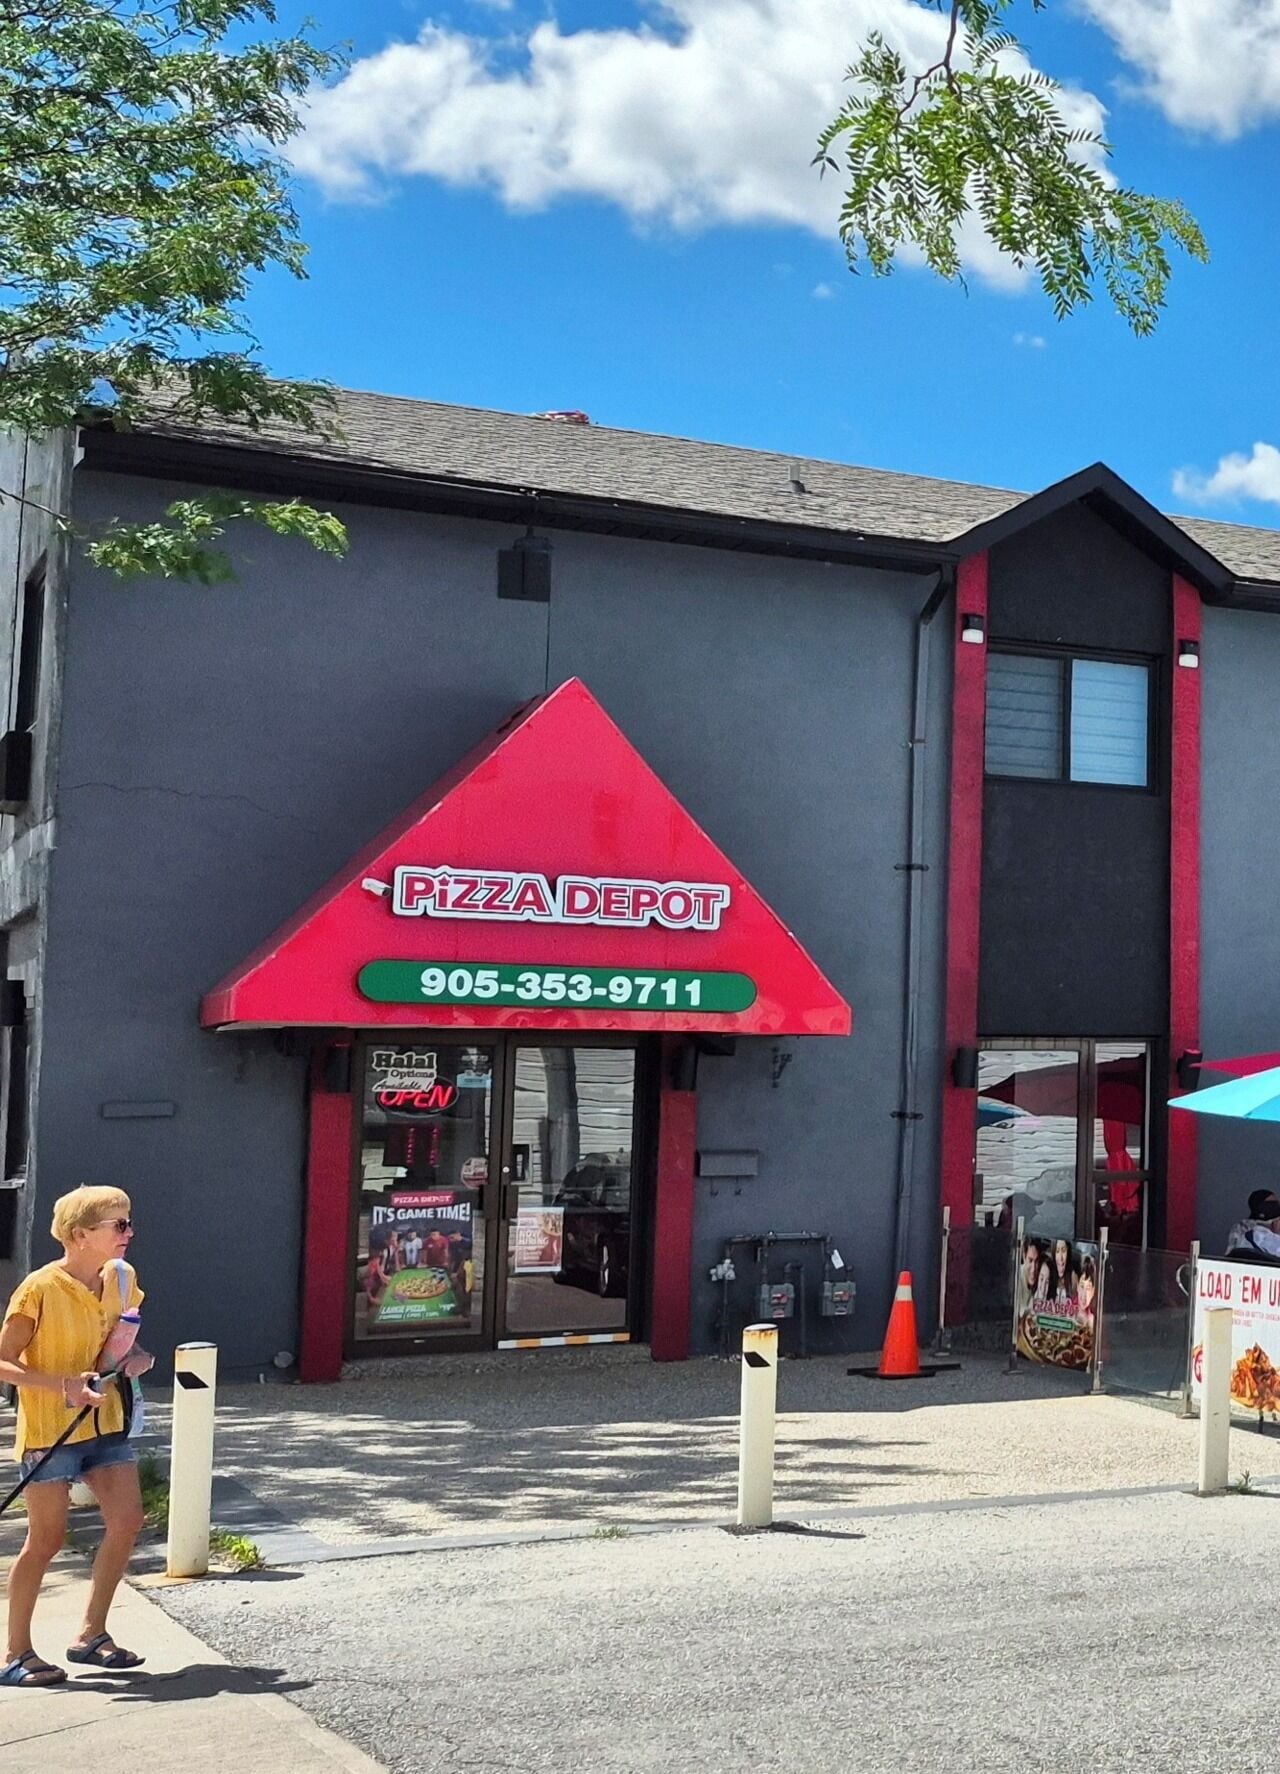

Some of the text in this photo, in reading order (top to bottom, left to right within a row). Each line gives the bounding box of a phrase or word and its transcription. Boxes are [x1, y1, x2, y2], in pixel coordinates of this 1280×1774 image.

[564, 884, 722, 923] DEPOT
[420, 968, 702, 1006] 905-353-9711
[374, 1052, 436, 1069] Halal
[390, 1069, 435, 1079] Options
[380, 1085, 453, 1107] OPEN
[393, 1195, 452, 1204] PIZZA DEPOT
[373, 1202, 470, 1226] IT'S GAME TIME!
[1200, 1271, 1232, 1300] LOAD
[1239, 1276, 1262, 1304] 'EM
